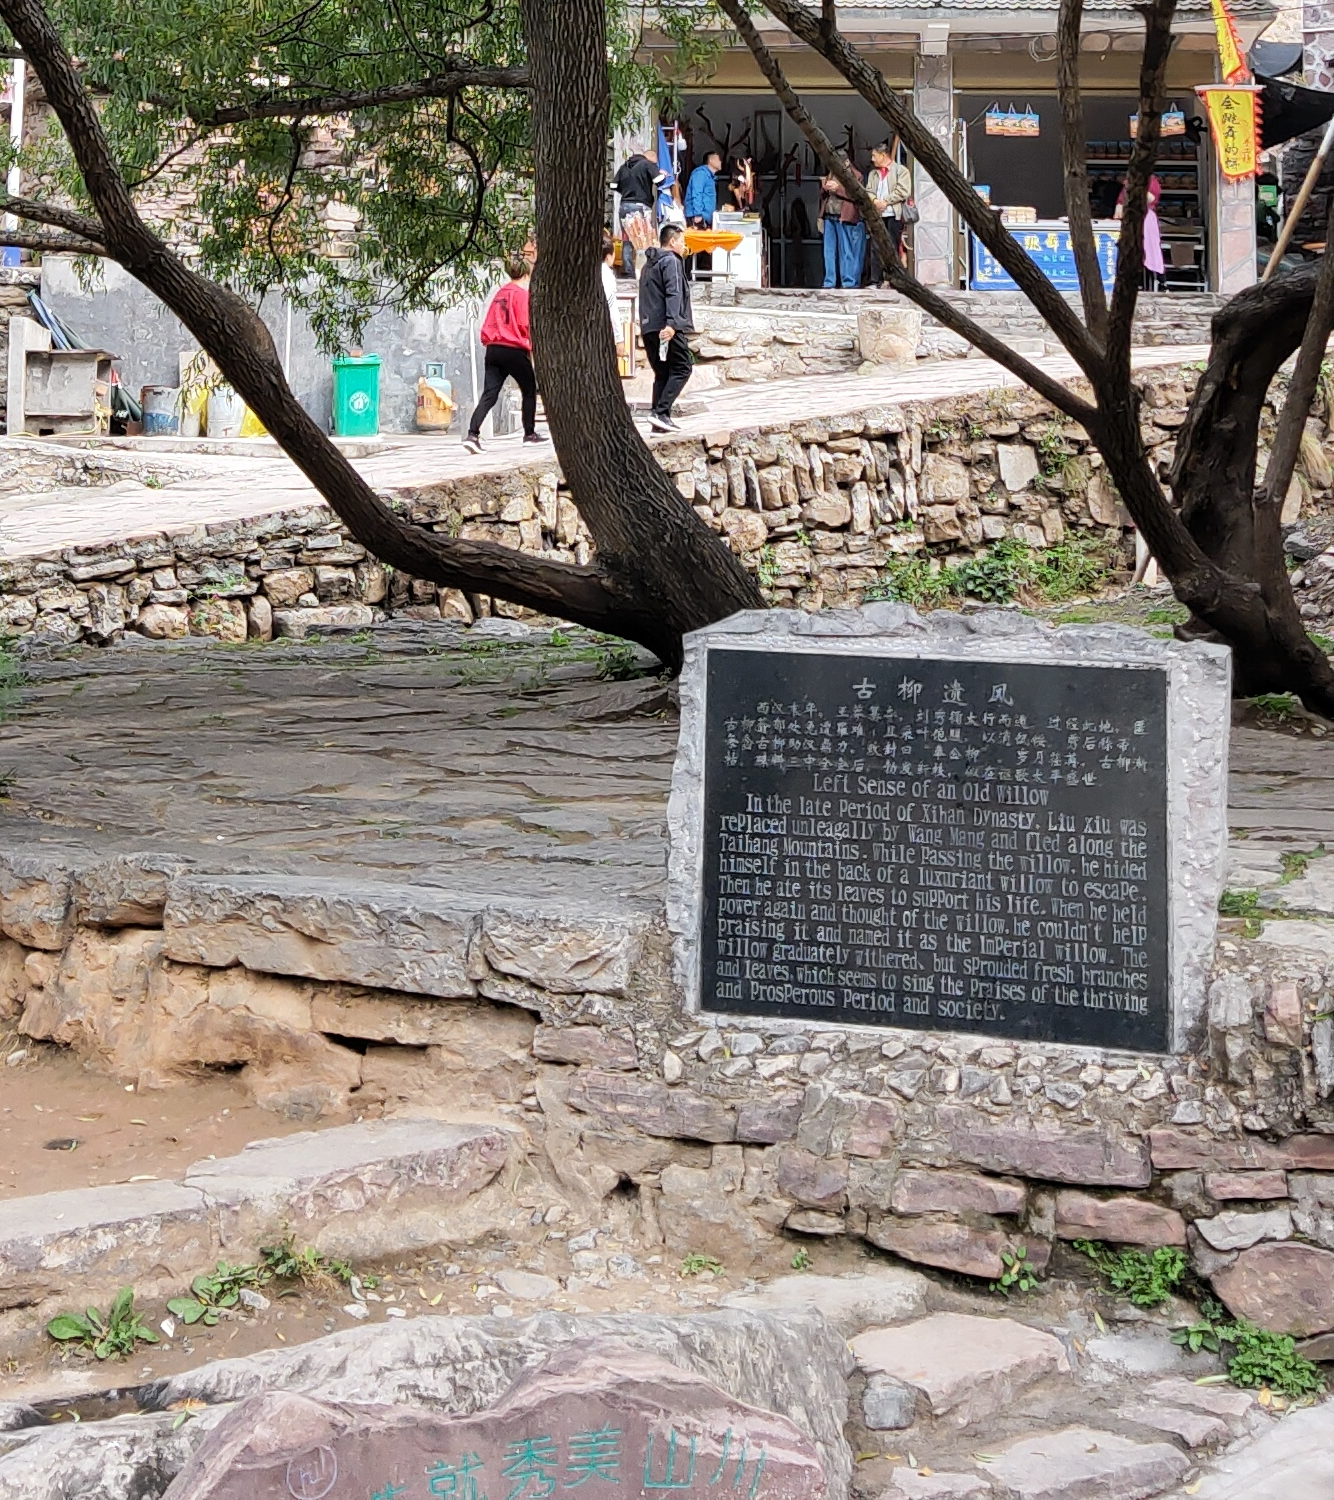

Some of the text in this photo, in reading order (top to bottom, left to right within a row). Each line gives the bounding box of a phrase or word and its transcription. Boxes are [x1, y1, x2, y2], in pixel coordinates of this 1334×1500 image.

[853, 676, 1014, 706] 古柳遗风
[813, 772, 851, 793] Left
[857, 775, 906, 796] Sense
[911, 779, 931, 798] of
[936, 782, 957, 799] an
[962, 782, 990, 801] Old
[745, 792, 763, 812] In
[765, 794, 791, 813] the
[798, 795, 831, 816] late
[896, 802, 915, 821] of
[919, 803, 965, 824] Xihan
[1047, 811, 1075, 832] Liu
[719, 832, 778, 856] Taihang
[987, 850, 1013, 870] the
[1081, 856, 1099, 876] he
[1103, 858, 1147, 880] hided
[882, 822, 899, 841] by
[907, 823, 942, 845] Wang
[949, 826, 985, 849] Mang
[991, 830, 1017, 849] and
[1026, 831, 1060, 852] fled
[1067, 834, 1113, 858] along
[1120, 837, 1147, 858] the
[718, 853, 778, 875] himself
[783, 857, 801, 877] in
[804, 859, 830, 878] the
[837, 860, 871, 881] back
[876, 864, 895, 883] of
[899, 868, 909, 884] a
[917, 866, 994, 890] luxuriant
[1000, 873, 1053, 893] willow
[1061, 877, 1078, 896] to
[717, 897, 761, 920] power
[764, 900, 806, 919] again
[810, 902, 836, 921] and
[841, 903, 897, 926] thought
[902, 908, 919, 927] of
[922, 909, 948, 930] the
[1013, 916, 1030, 936] he
[718, 874, 750, 894] Then
[754, 876, 771, 895] he
[776, 878, 801, 897] ate
[808, 880, 831, 899] its
[836, 881, 884, 903] leaves
[890, 886, 907, 905] to
[975, 891, 1000, 911] his
[1089, 900, 1106, 920] he
[1112, 902, 1146, 924] held
[716, 937, 767, 957] willow
[933, 952, 956, 973] but
[1033, 961, 1075, 983] fresh
[1081, 964, 1147, 990] branches
[717, 917, 785, 941] praising
[793, 921, 809, 940] it
[816, 923, 842, 943] and
[847, 927, 890, 946] named
[896, 928, 912, 948] it
[919, 933, 937, 950] as
[945, 932, 971, 952] the
[1120, 946, 1148, 968] The
[715, 979, 742, 999] and
[903, 994, 929, 1014] and
[716, 958, 739, 976] and
[837, 969, 876, 988] seems
[881, 970, 896, 989] to
[902, 973, 934, 993] sing
[940, 975, 963, 995] the
[1030, 983, 1049, 1003] of
[1054, 985, 1078, 1005] the
[1082, 987, 1148, 1015] thriving
[371, 1421, 770, 1500] 就秀美山川
